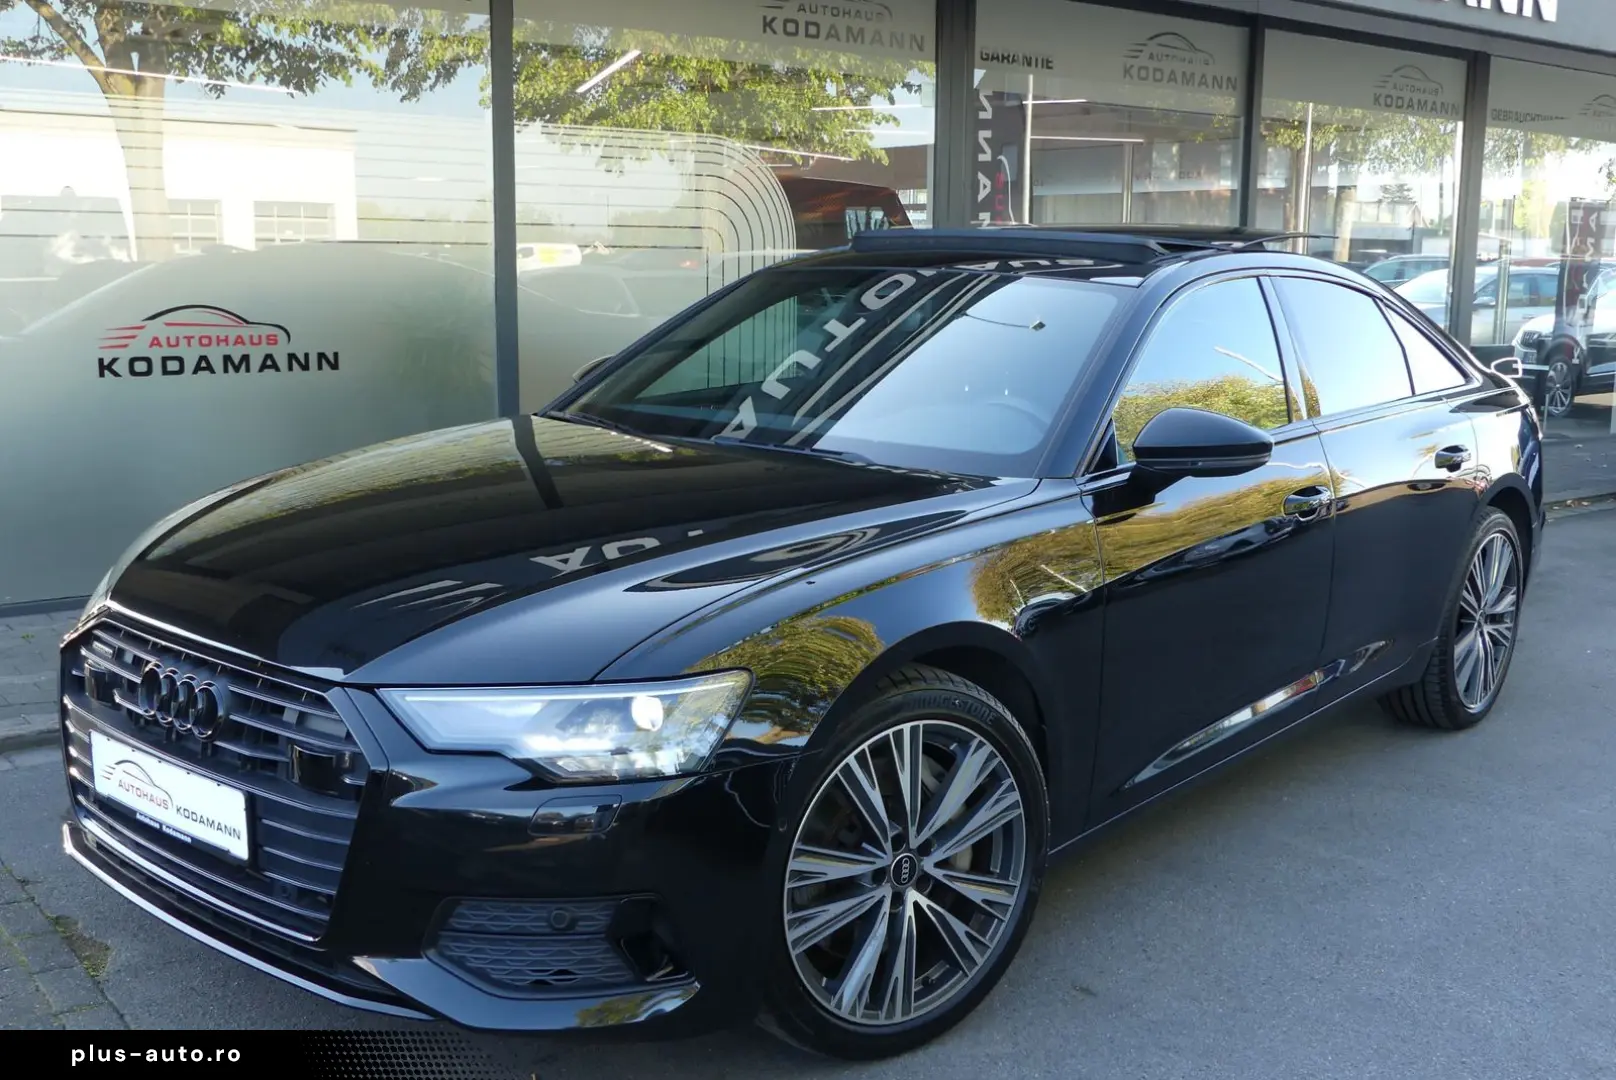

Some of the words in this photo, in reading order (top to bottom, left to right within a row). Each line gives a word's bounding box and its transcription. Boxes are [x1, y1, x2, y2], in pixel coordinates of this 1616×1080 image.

[762, 15, 926, 52] KODAMANN
[979, 50, 1054, 70] GARANTIE
[1123, 62, 1238, 91] KODAMANN
[1373, 92, 1460, 117] KODAMANN
[148, 333, 279, 349] AUTOHAUS
[98, 351, 340, 379] KODAMANN
[118, 779, 169, 810] AUTOHAUS
[176, 804, 241, 841] KODAMANN
